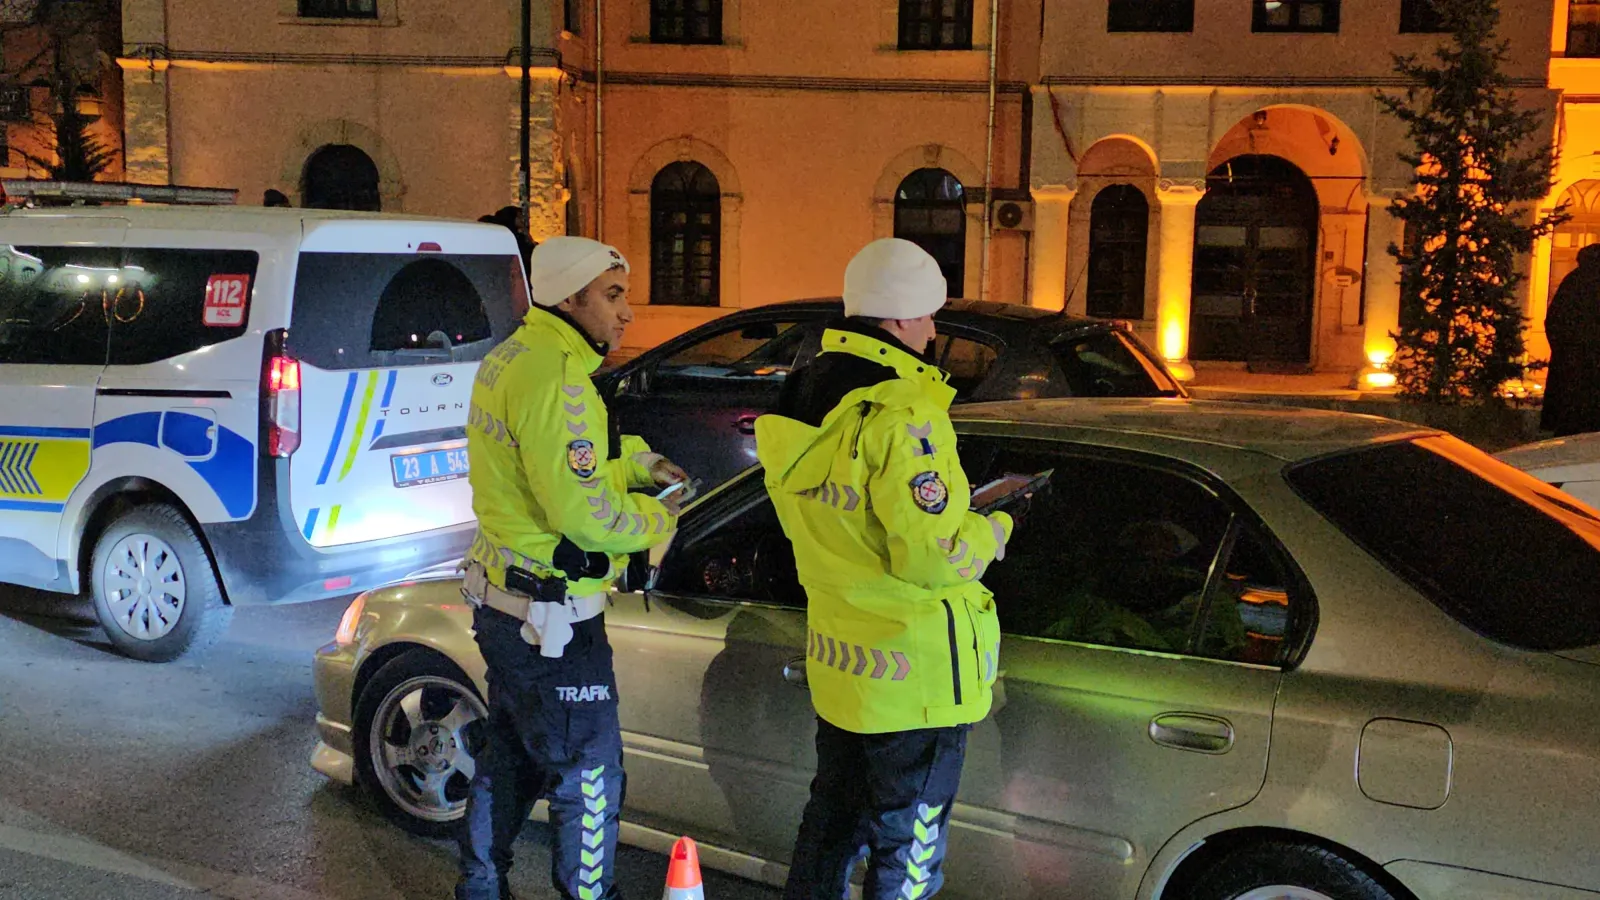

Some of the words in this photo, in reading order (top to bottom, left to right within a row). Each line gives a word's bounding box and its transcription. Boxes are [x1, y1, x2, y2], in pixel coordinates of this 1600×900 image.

[212, 279, 242, 304] 112
[380, 402, 463, 417] TOURN
[402, 456, 420, 479] 23
[430, 454, 440, 475] A
[446, 450, 470, 472] 543
